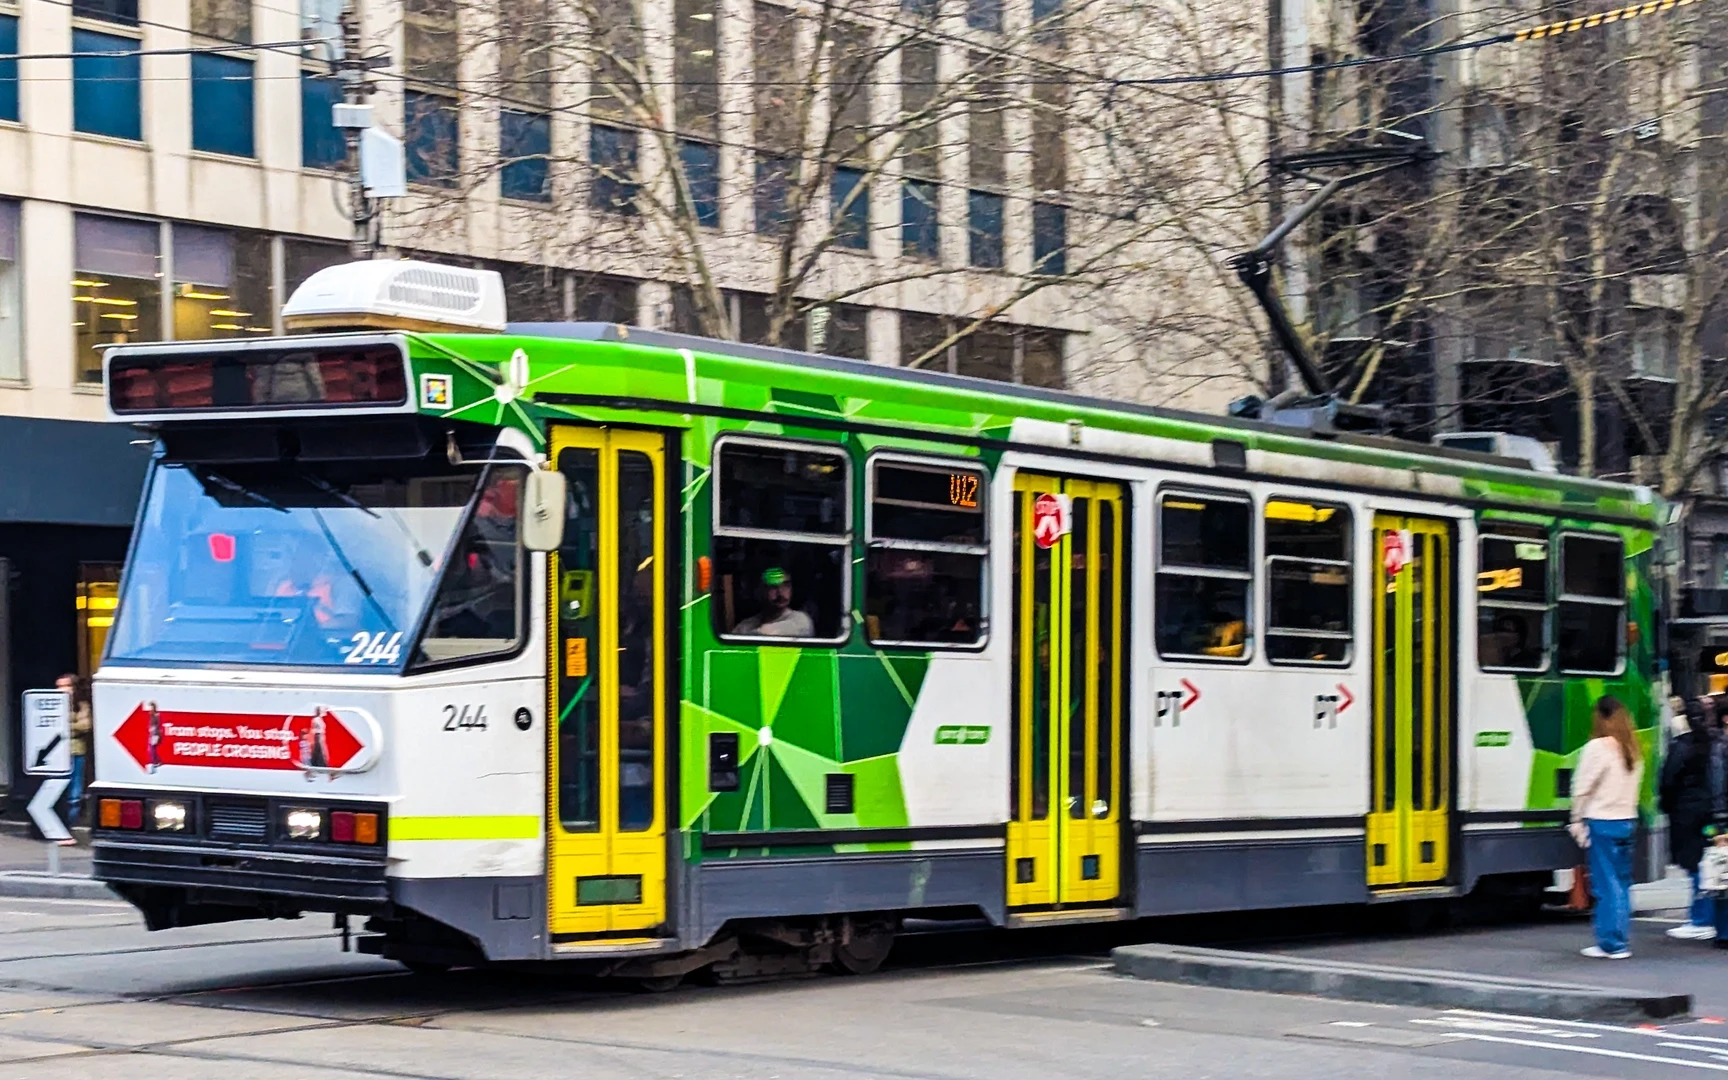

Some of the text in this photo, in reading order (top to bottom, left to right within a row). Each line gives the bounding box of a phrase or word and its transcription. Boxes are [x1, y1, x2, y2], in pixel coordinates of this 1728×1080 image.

[344, 631, 403, 664] 244
[442, 704, 488, 732] 244
[173, 742, 291, 759] PEOPLE CROSSING
